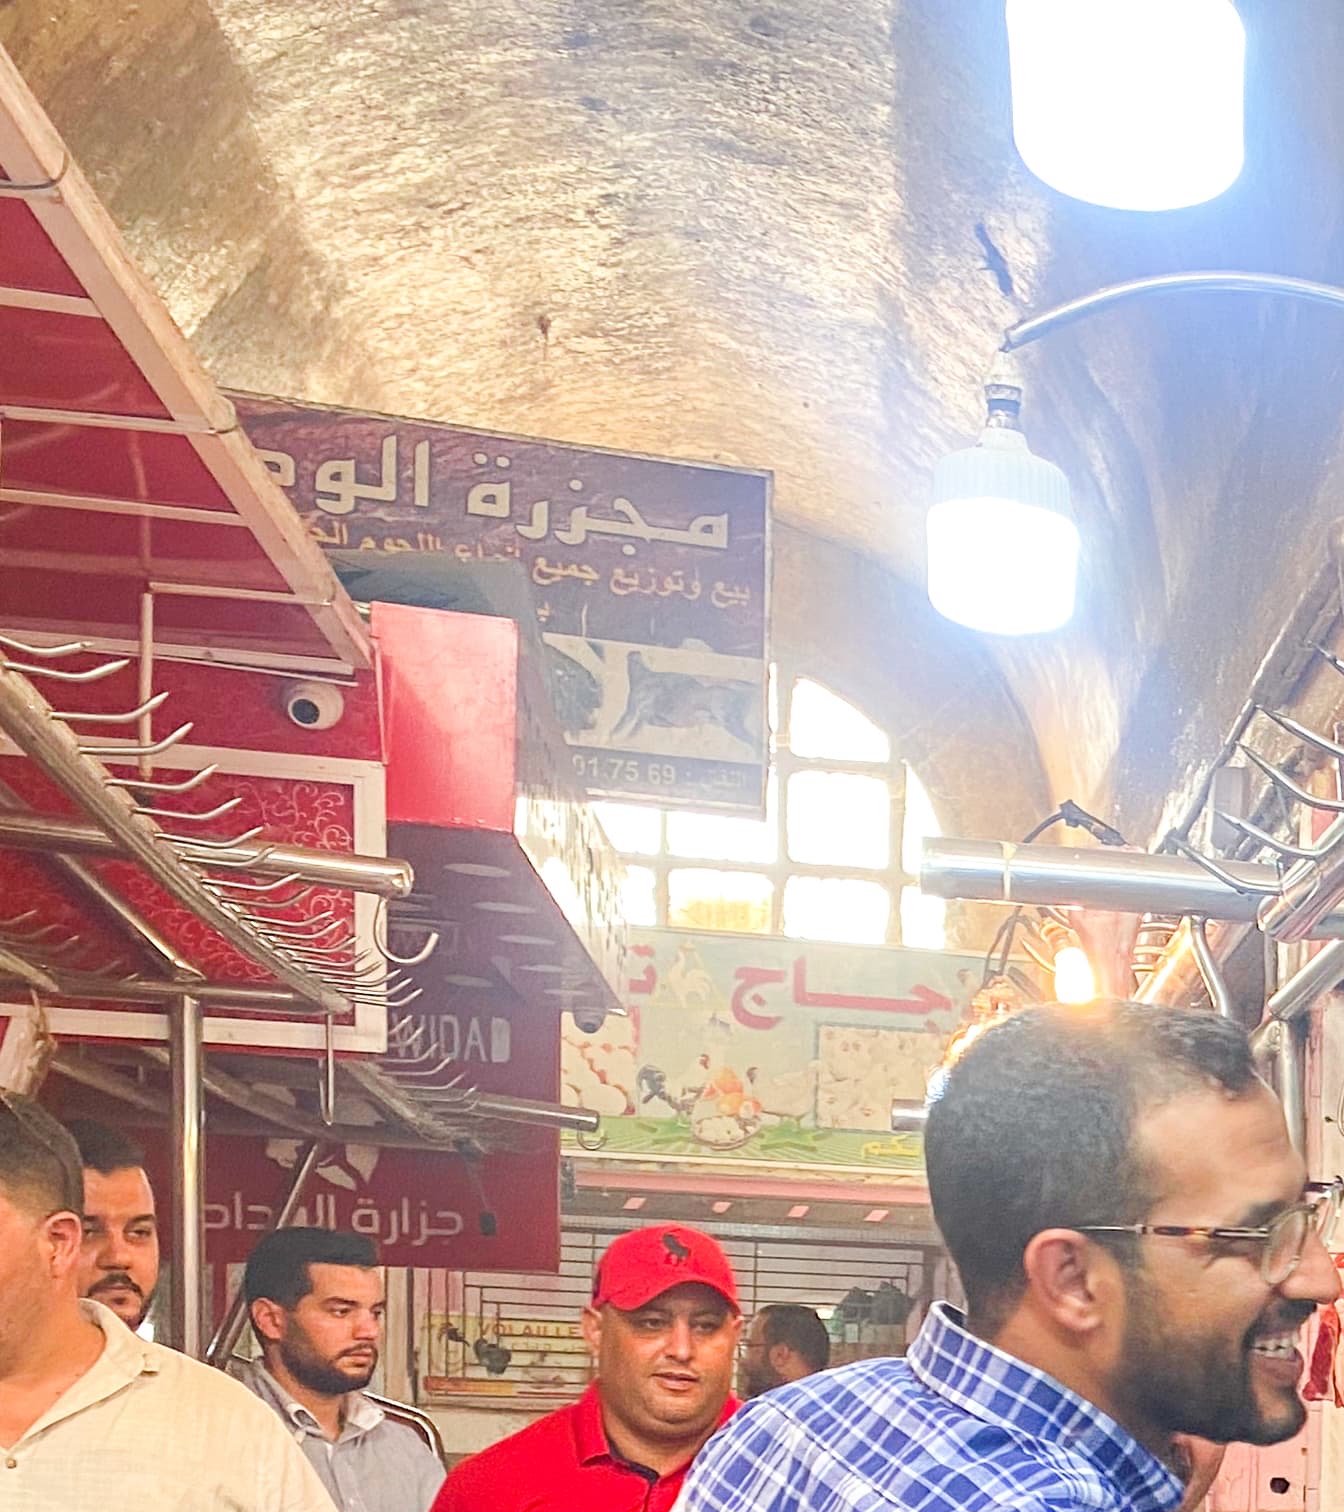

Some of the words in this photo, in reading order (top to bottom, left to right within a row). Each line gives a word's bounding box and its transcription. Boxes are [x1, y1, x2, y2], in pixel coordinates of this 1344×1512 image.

[467, 452, 729, 556] مجزرة
[532, 556, 600, 586] جميع
[730, 957, 954, 1034] جاج
[352, 1197, 464, 1246] جزارة
